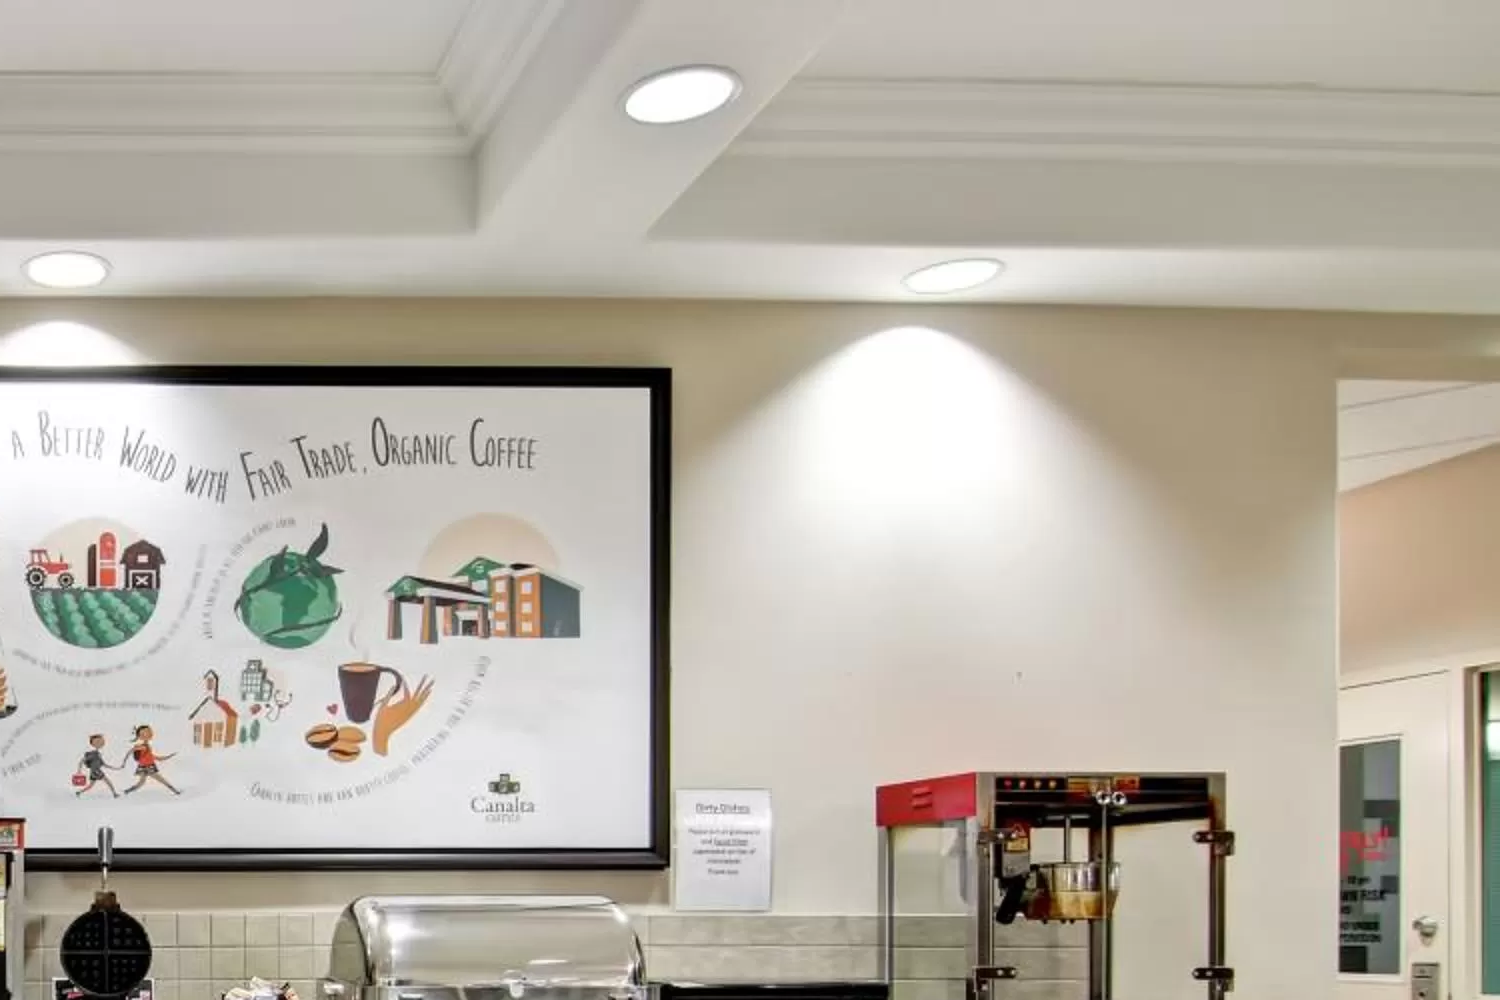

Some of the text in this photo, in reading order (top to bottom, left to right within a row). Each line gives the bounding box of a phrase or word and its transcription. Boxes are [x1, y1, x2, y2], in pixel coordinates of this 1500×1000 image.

[38, 410, 105, 460] BETTER
[120, 425, 178, 483] WORLD
[240, 451, 293, 500] FAIR
[371, 416, 457, 467] ORGANIC
[469, 417, 540, 469] COFFEE
[470, 796, 536, 813] Canalta
